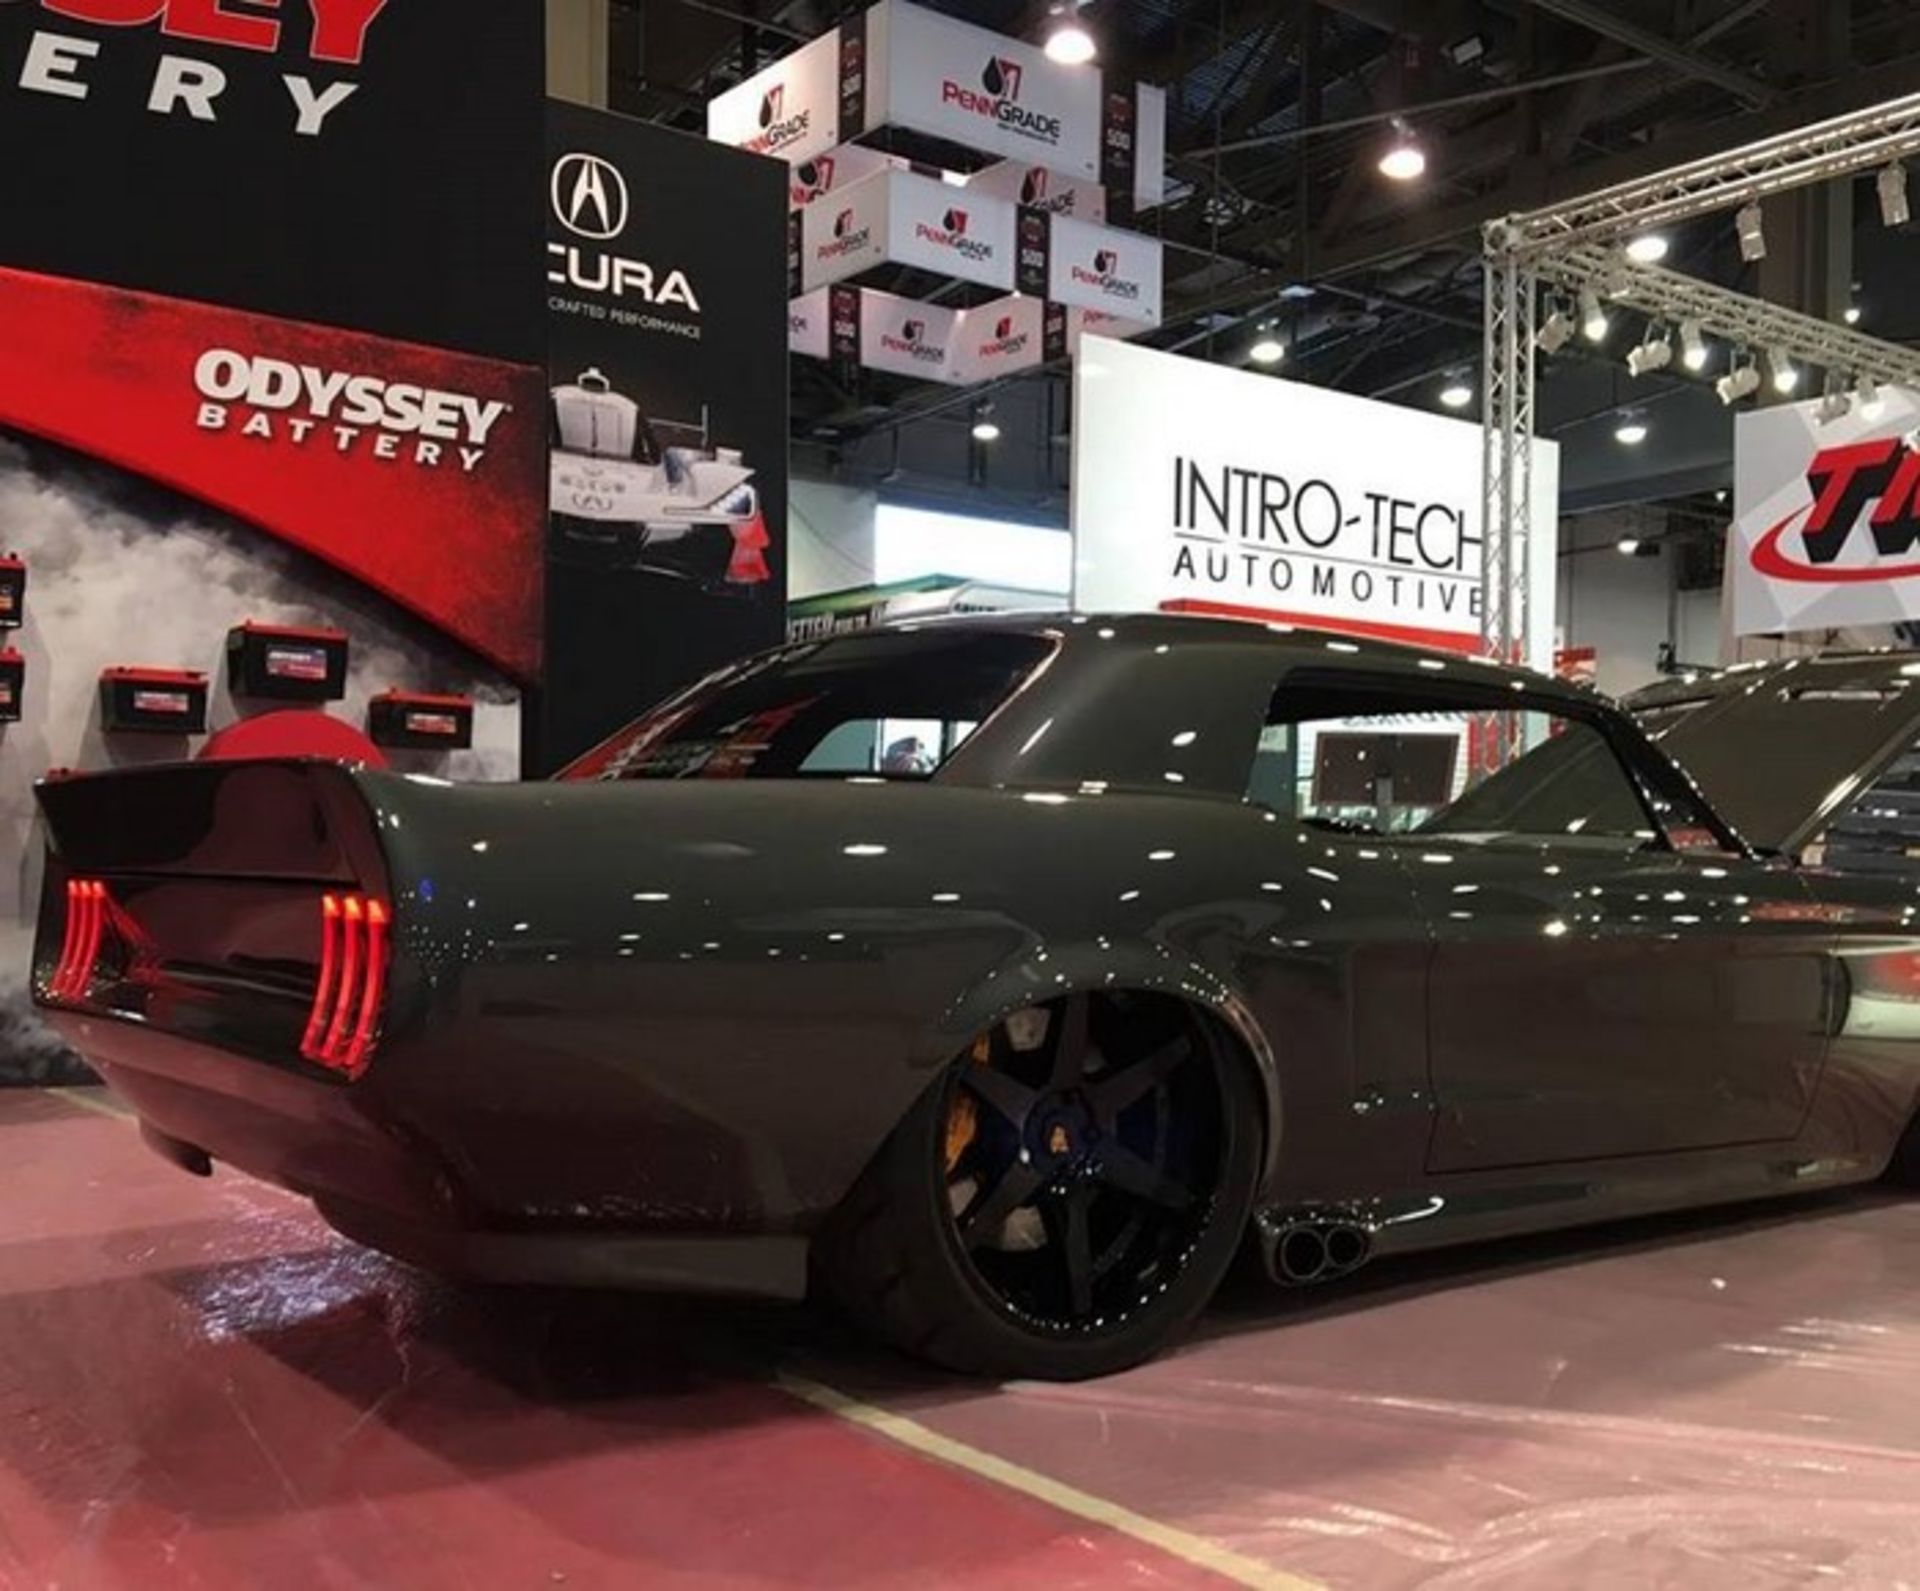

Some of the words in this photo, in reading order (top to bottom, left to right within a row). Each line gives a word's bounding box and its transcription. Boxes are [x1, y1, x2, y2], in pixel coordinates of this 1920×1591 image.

[19, 30, 359, 136] ERY
[194, 349, 504, 444] ODYSSEY
[197, 402, 484, 471] BATTERY
[1173, 456, 1483, 571] INTRO-TECH
